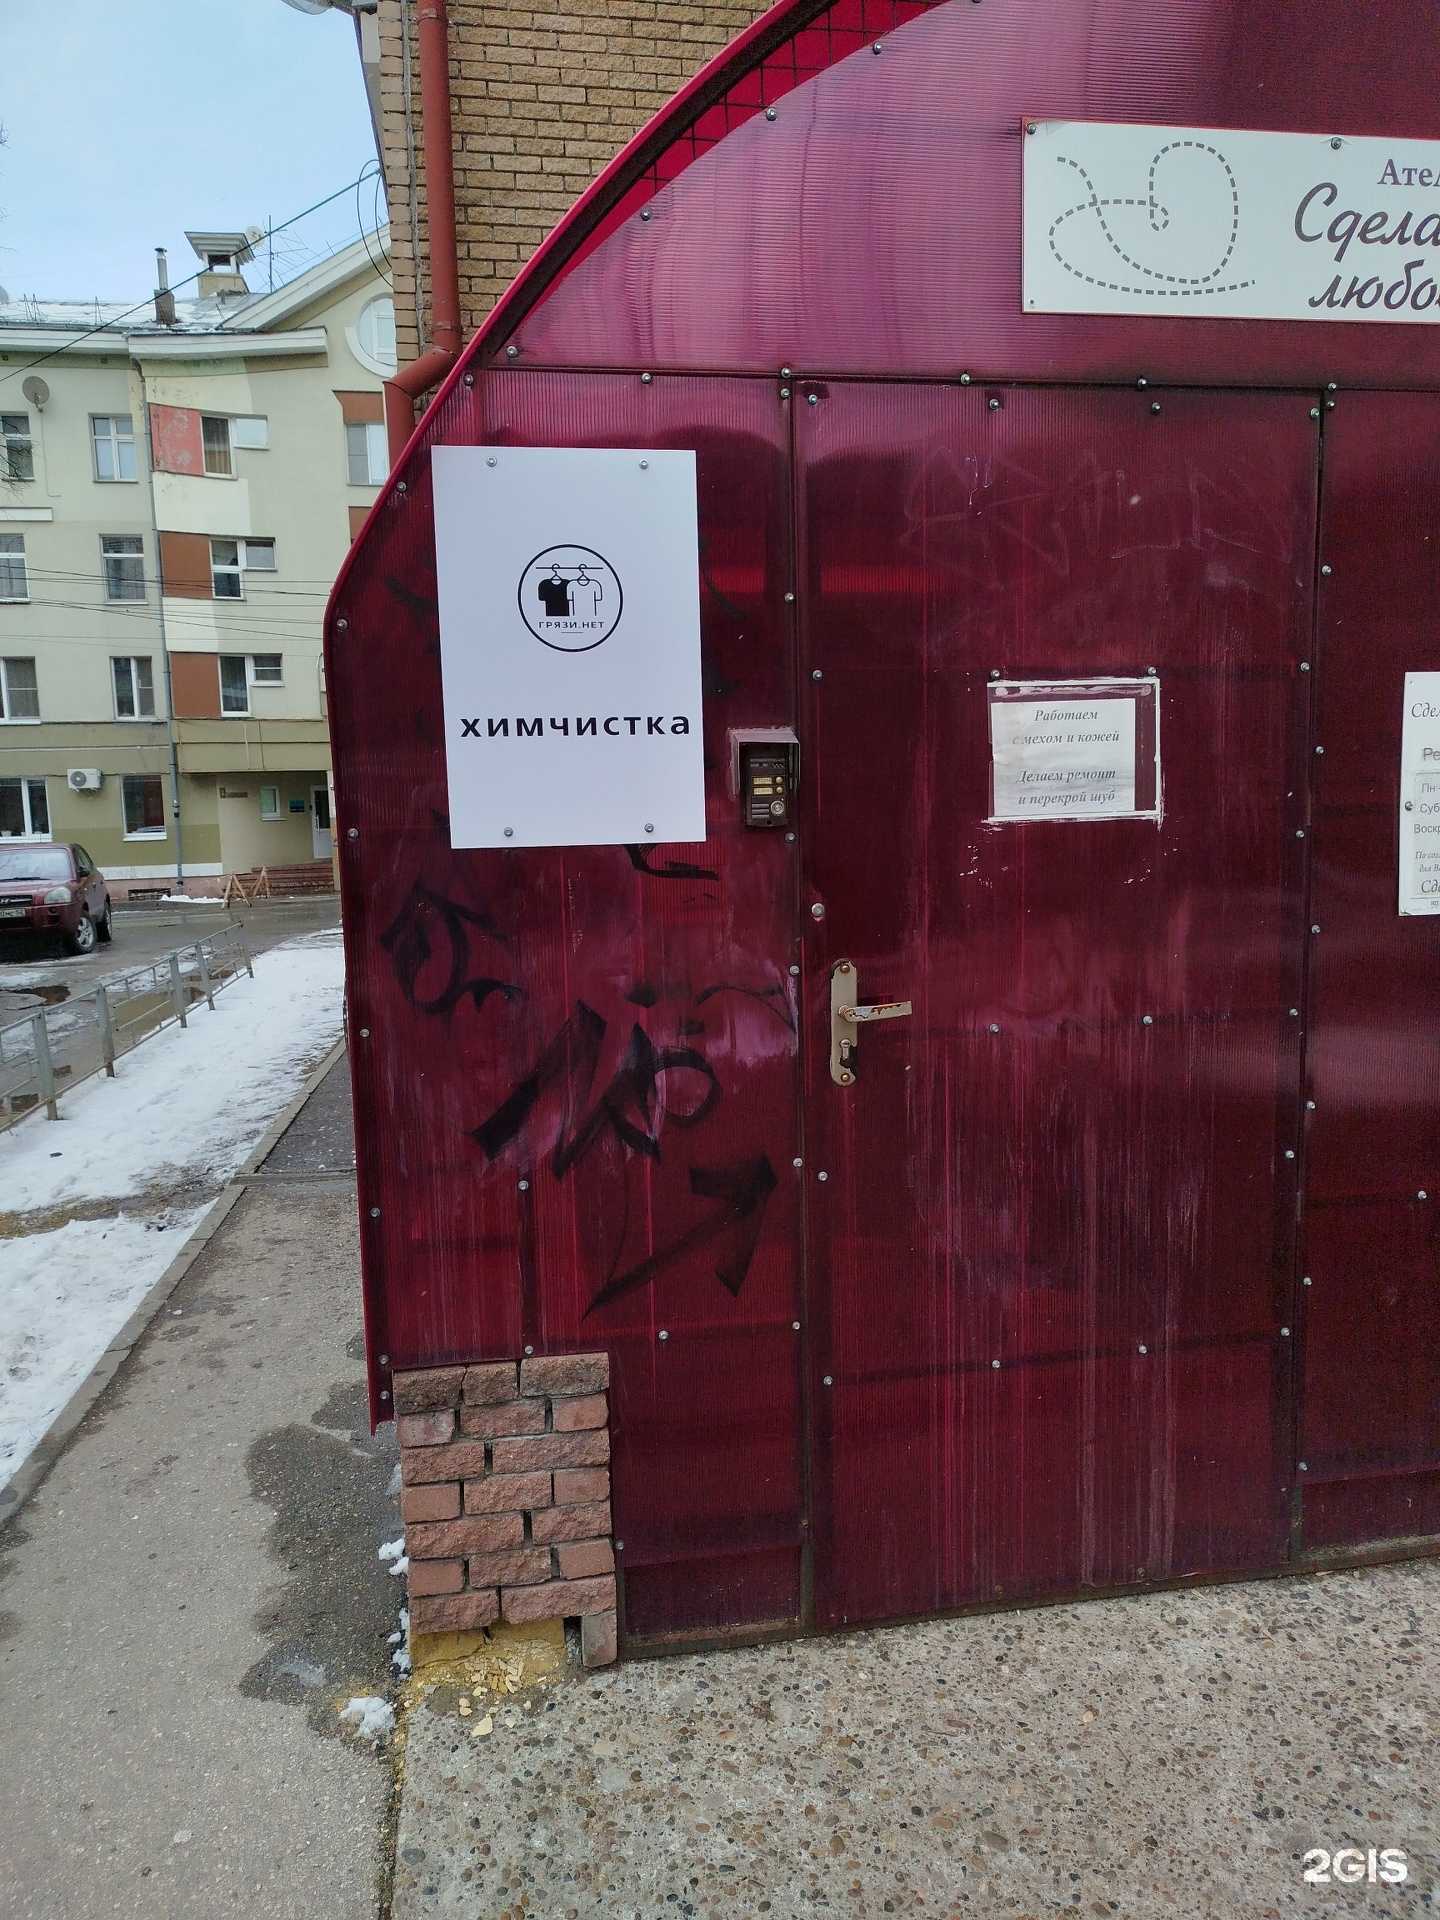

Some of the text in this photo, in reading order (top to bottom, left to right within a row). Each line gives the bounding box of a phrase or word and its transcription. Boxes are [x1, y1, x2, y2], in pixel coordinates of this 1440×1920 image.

[1308, 259, 1440, 310] любо
[538, 621, 605, 629] ГРЯЗИ.НЕТ
[1034, 709, 1098, 722] Работаем
[459, 715, 690, 738] химчистка
[1012, 731, 1120, 745] с мехом и кожей
[1016, 768, 1116, 785] Делаем ремонт
[1018, 790, 1115, 807] и перекрой шуб
